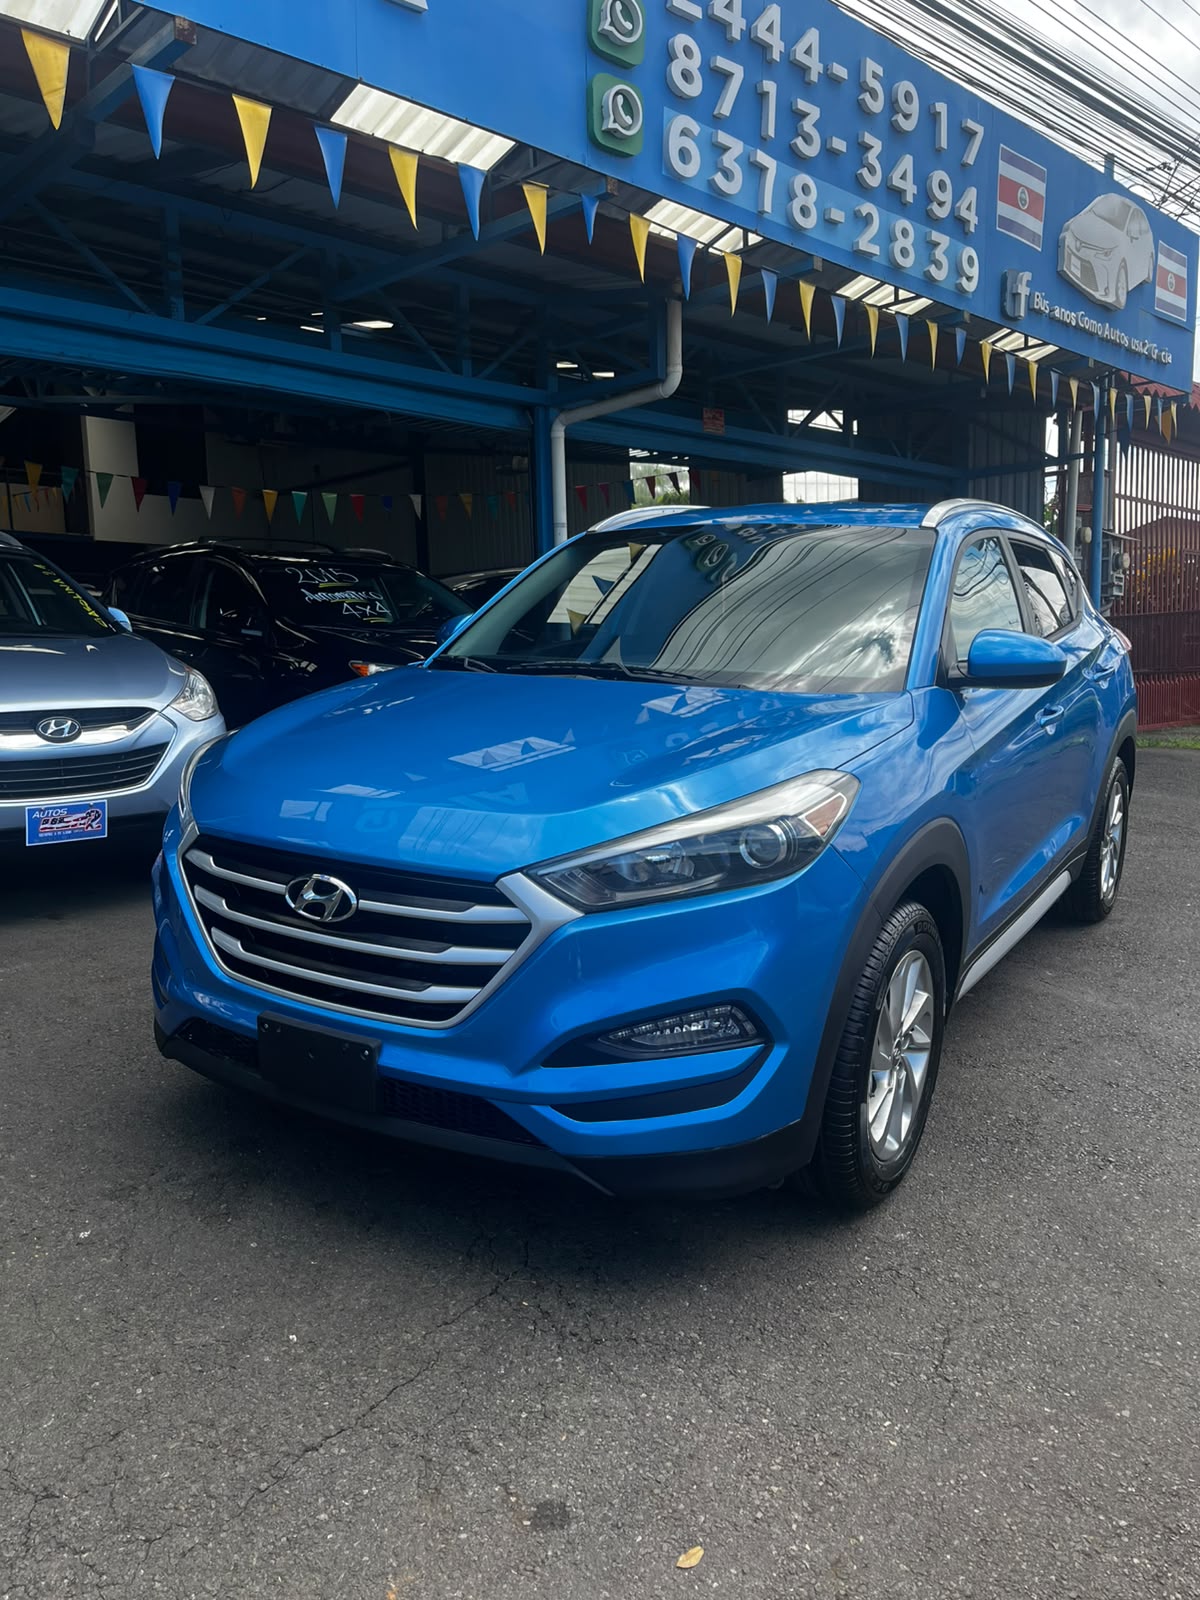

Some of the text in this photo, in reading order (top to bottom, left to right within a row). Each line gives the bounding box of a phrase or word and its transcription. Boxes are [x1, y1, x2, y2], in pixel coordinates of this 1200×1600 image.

[666, 0, 985, 167] 444-5917
[666, 33, 979, 233] 8713-3494
[665, 114, 980, 293] 6378-2839
[1078, 311, 1103, 335] Como
[1103, 322, 1129, 347] Autos
[284, 566, 359, 584] 2015
[32, 807, 68, 819] AUTOS
